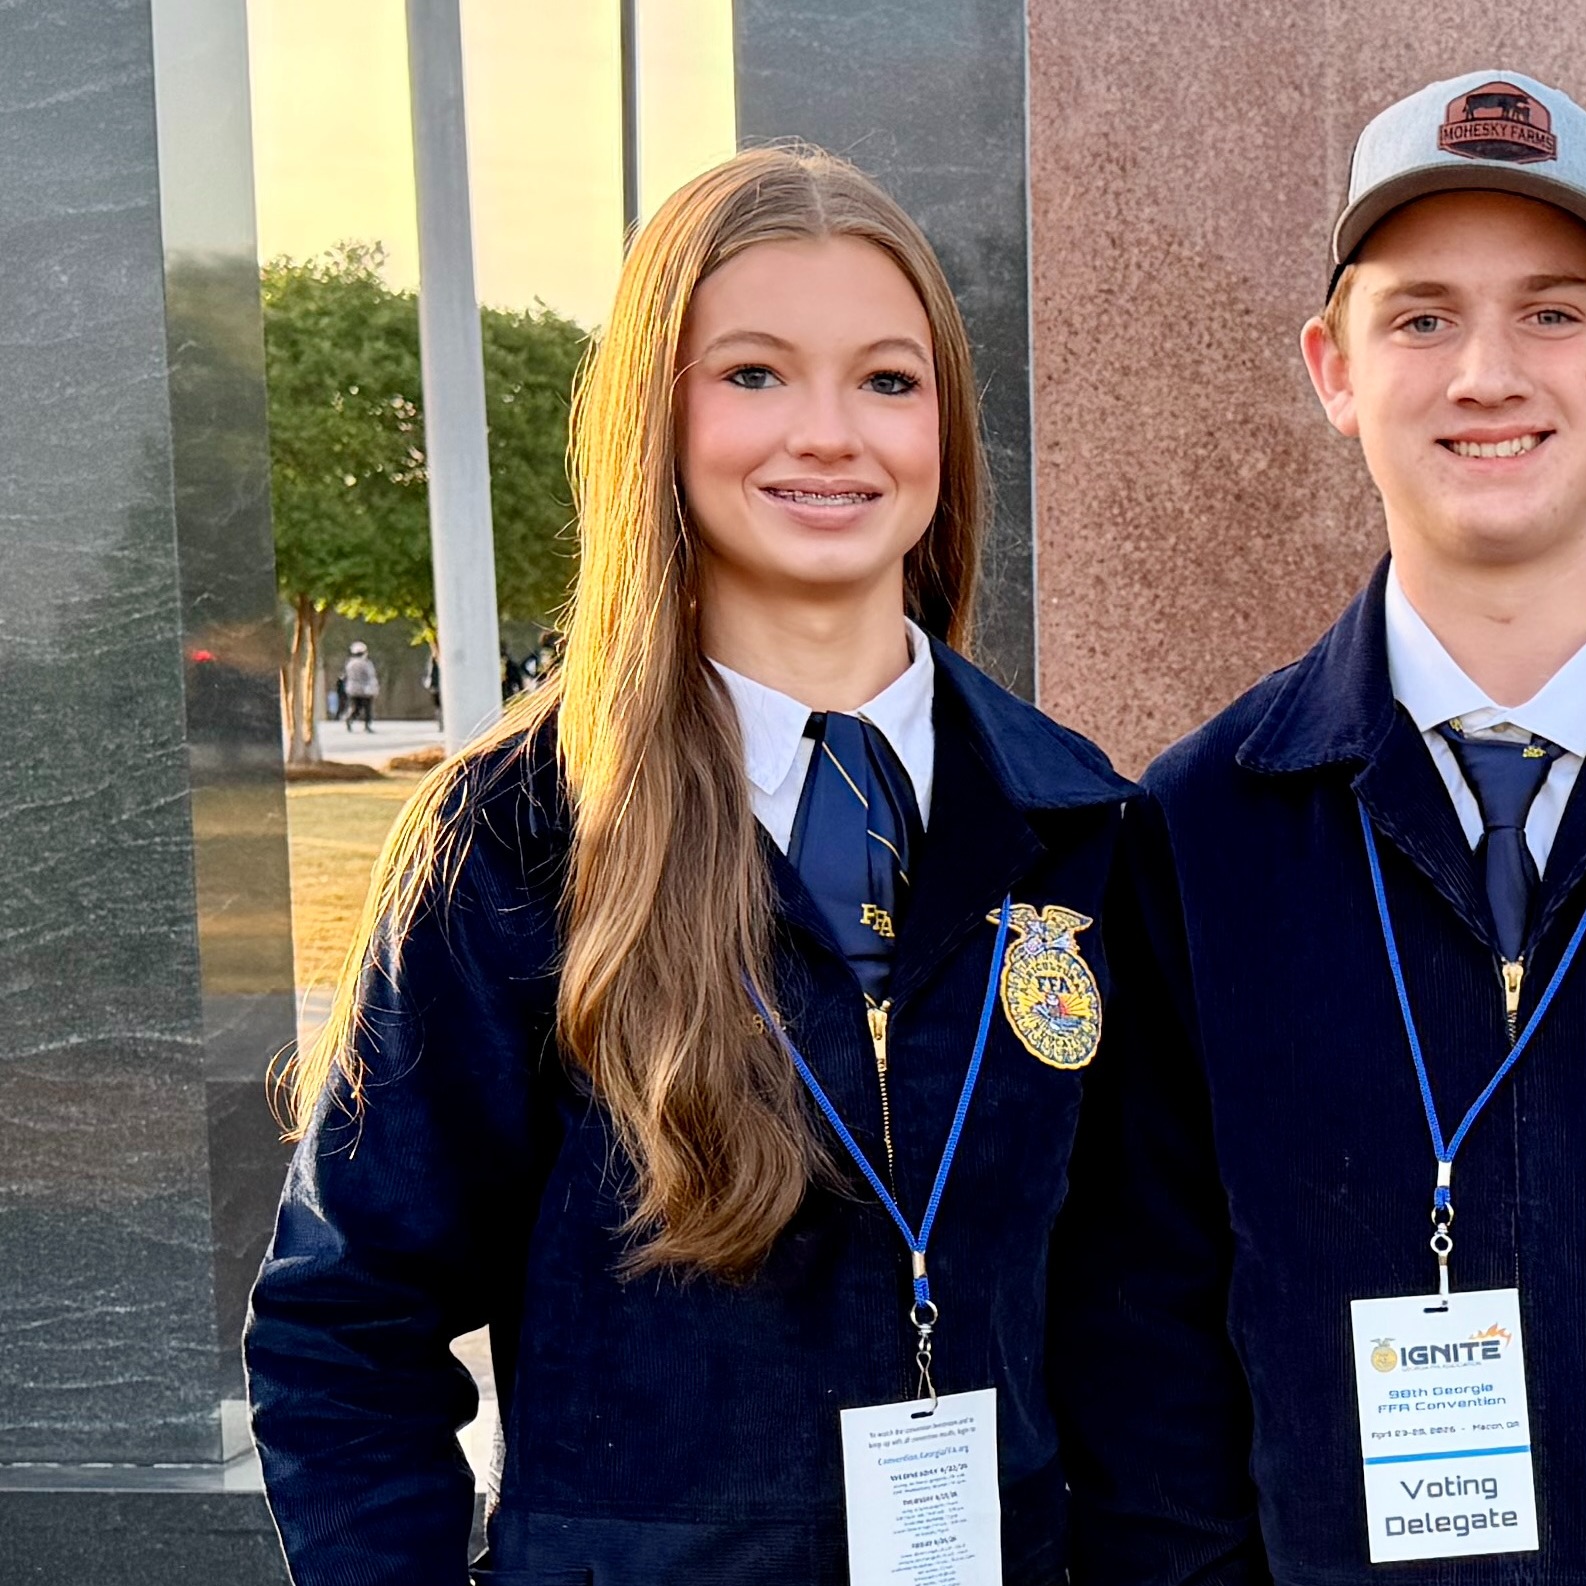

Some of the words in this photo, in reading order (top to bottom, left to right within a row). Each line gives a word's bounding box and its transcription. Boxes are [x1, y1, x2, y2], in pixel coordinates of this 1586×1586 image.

[1443, 122, 1508, 141] MOHESKY
[1510, 126, 1554, 150] FARMS
[860, 903, 896, 938] FFA
[1036, 975, 1071, 994] FFA
[1400, 1340, 1502, 1367] IGNITE
[1388, 1388, 1428, 1400] 98th
[1432, 1383, 1494, 1397] Georgia
[1378, 1403, 1410, 1414] FFA
[1415, 1396, 1507, 1411] Convention
[1400, 1475, 1498, 1500] Voting
[1385, 1508, 1518, 1537] Delegate
